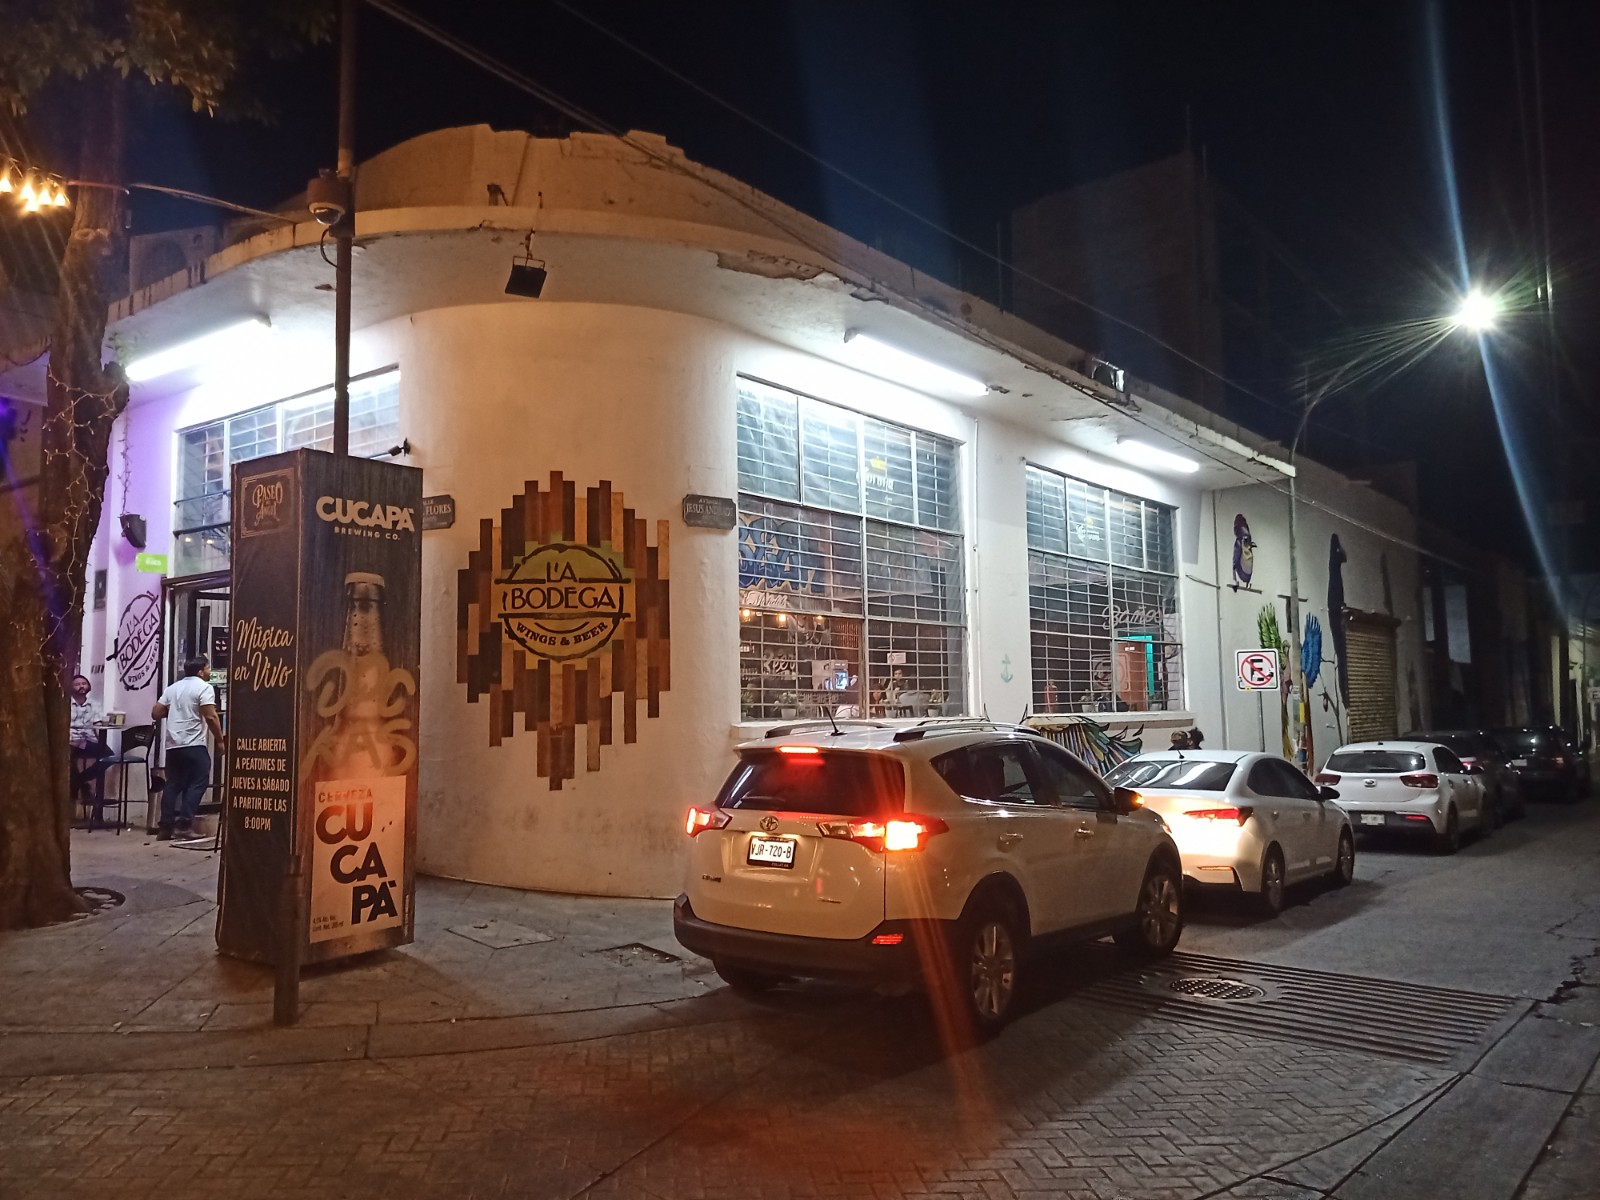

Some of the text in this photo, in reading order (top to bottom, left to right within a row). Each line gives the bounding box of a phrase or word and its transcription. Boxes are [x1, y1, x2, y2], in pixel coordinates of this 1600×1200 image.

[334, 526, 380, 538] BREWING
[511, 586, 616, 610] BODEGA
[1101, 604, 1163, 630] Baños
[119, 612, 159, 670] BODEGA
[236, 616, 294, 664] Música
[516, 621, 609, 646] WINGS & BEER
[234, 666, 251, 681] en
[251, 651, 293, 692] Vivo
[236, 738, 287, 752] CALLE ABIERTA
[235, 757, 287, 772] A PEATONES DE
[231, 776, 290, 792] JUEVES A SÁBADO
[318, 788, 374, 803] CERVEZA
[232, 796, 287, 813] A PARTIR DE LAS
[316, 803, 374, 845] CU
[330, 841, 388, 885] CA
